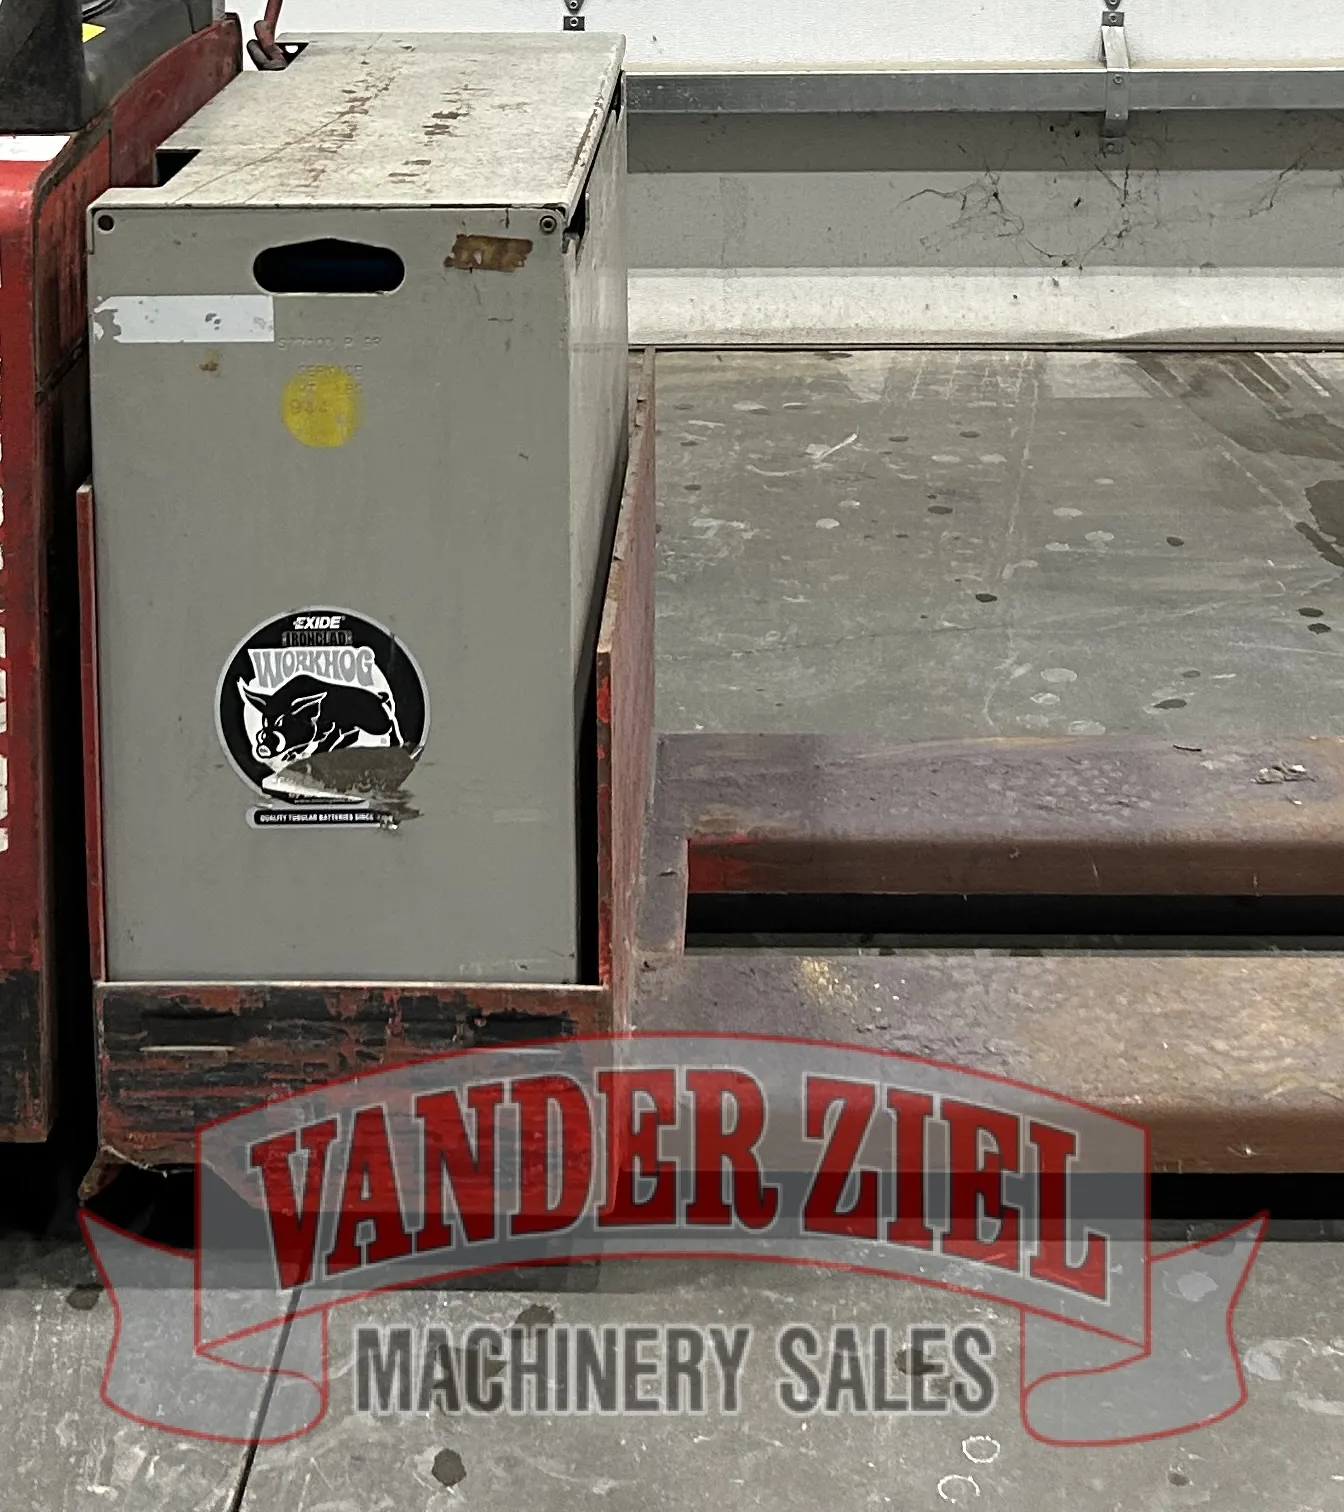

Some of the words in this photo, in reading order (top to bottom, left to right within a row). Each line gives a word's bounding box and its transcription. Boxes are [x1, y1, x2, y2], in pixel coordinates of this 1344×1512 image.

[292, 615, 342, 630] EXIDE
[285, 631, 349, 646] IRONCLAD
[251, 647, 376, 688] WORKHOG
[260, 813, 288, 822] QUALITY
